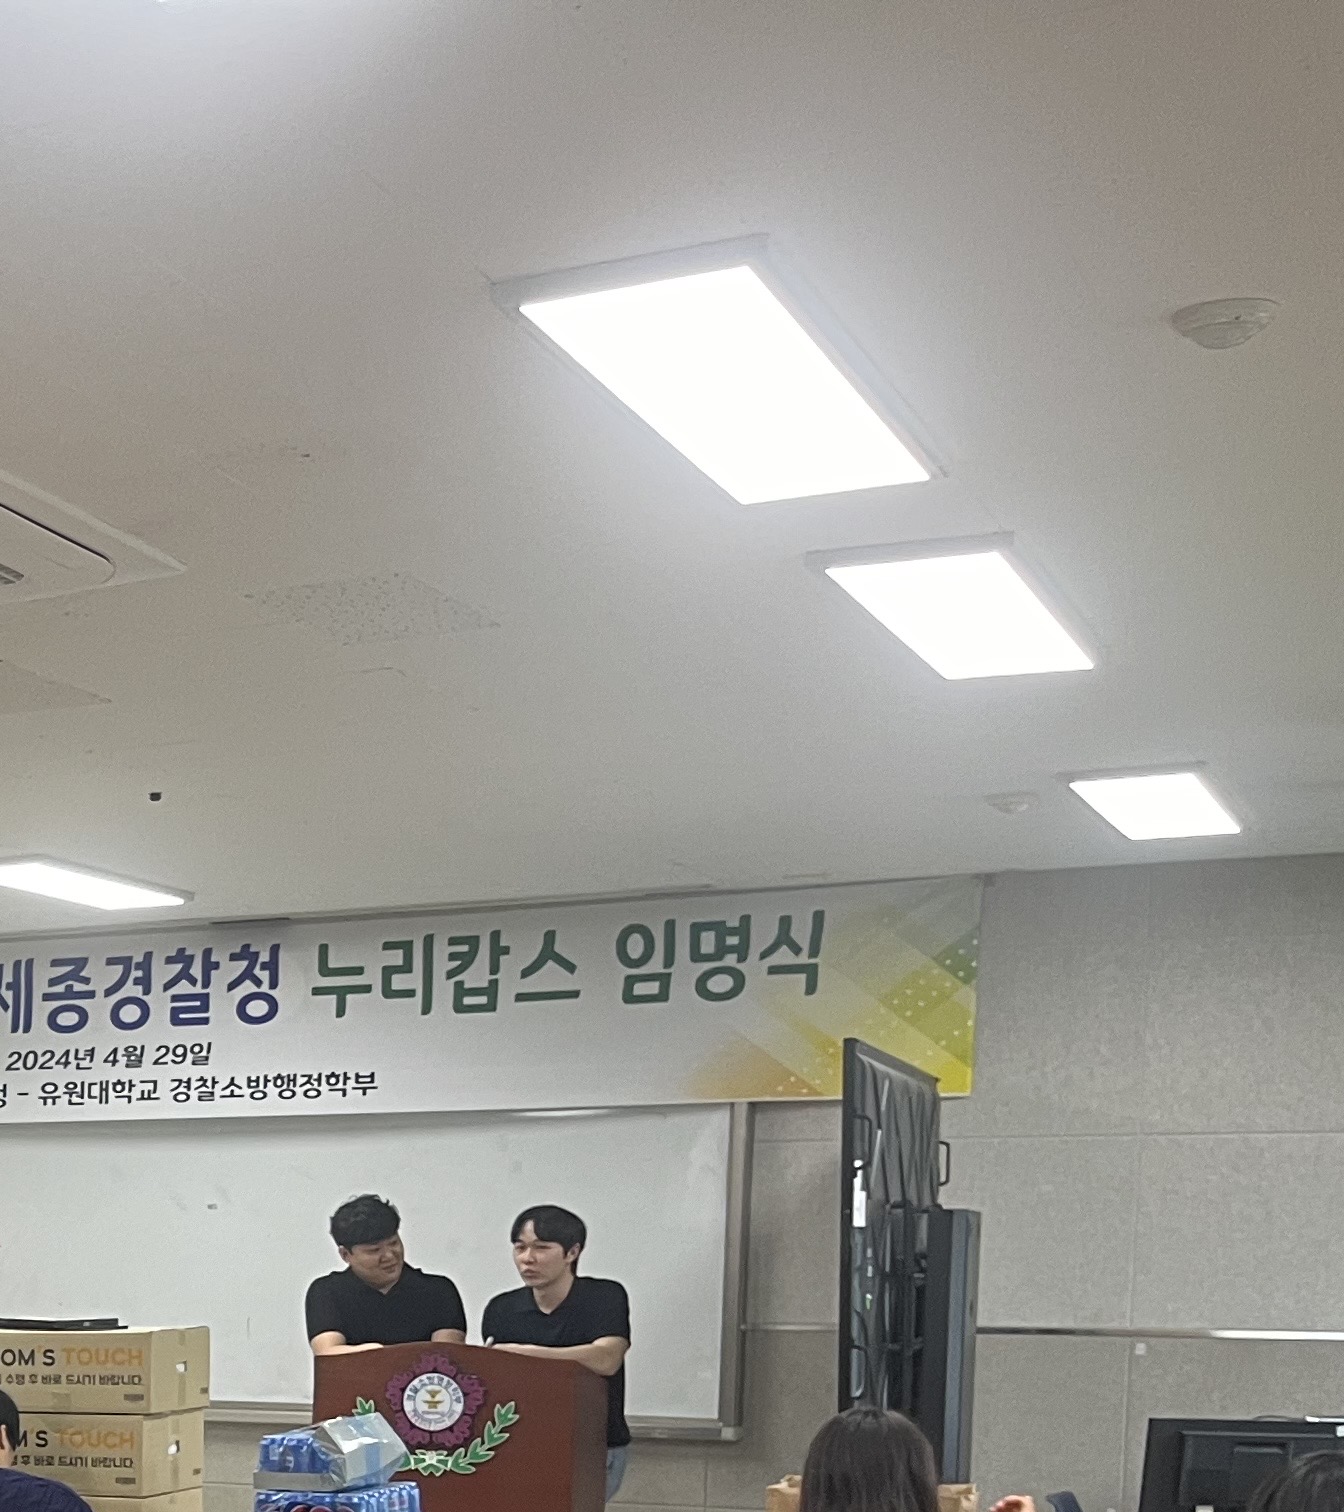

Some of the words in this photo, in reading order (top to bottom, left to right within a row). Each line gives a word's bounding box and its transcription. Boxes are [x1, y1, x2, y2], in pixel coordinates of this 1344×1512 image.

[311, 928, 581, 1019] 누리캅스
[615, 909, 826, 1005] 임명식
[5, 1045, 96, 1072] 2024년
[102, 1045, 144, 1070] 4월
[153, 1041, 213, 1066] 29일
[37, 1079, 162, 1107] 유원대학교
[169, 1070, 379, 1103] 경찰소방행정학부
[62, 1347, 145, 1367] TOUCH
[59, 1429, 136, 1450] TOUCH
